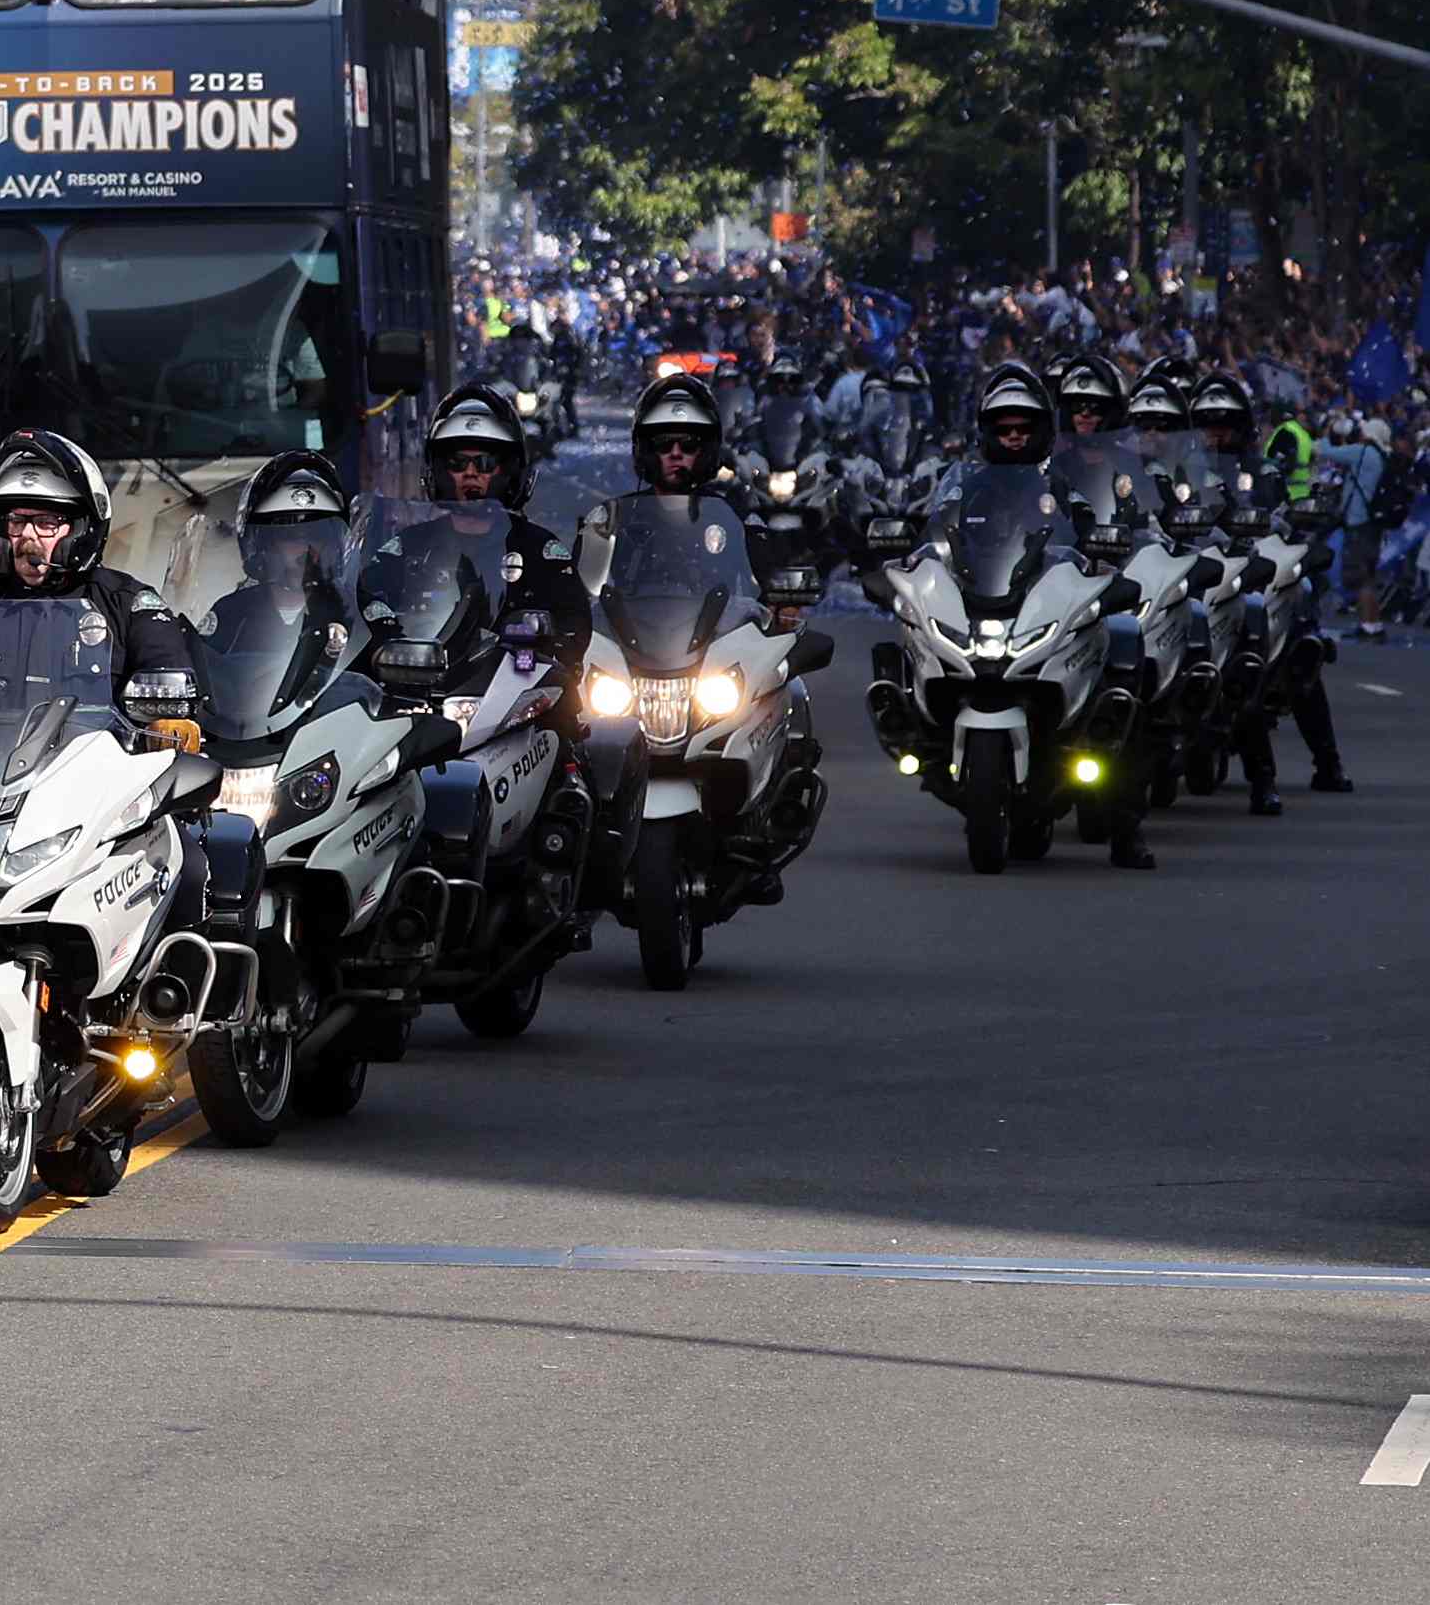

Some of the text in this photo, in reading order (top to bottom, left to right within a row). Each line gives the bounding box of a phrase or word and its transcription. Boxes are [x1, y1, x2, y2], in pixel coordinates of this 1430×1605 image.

[189, 73, 255, 92] 2025
[12, 98, 299, 153] CHAMPIONS
[67, 173, 123, 186] RESORT
[130, 174, 140, 185] &
[145, 172, 203, 185] CASINO
[102, 187, 177, 196] SAN MANUEL
[512, 733, 549, 785] POLICE
[353, 806, 395, 854] POLICE
[93, 856, 144, 912] POLICE
